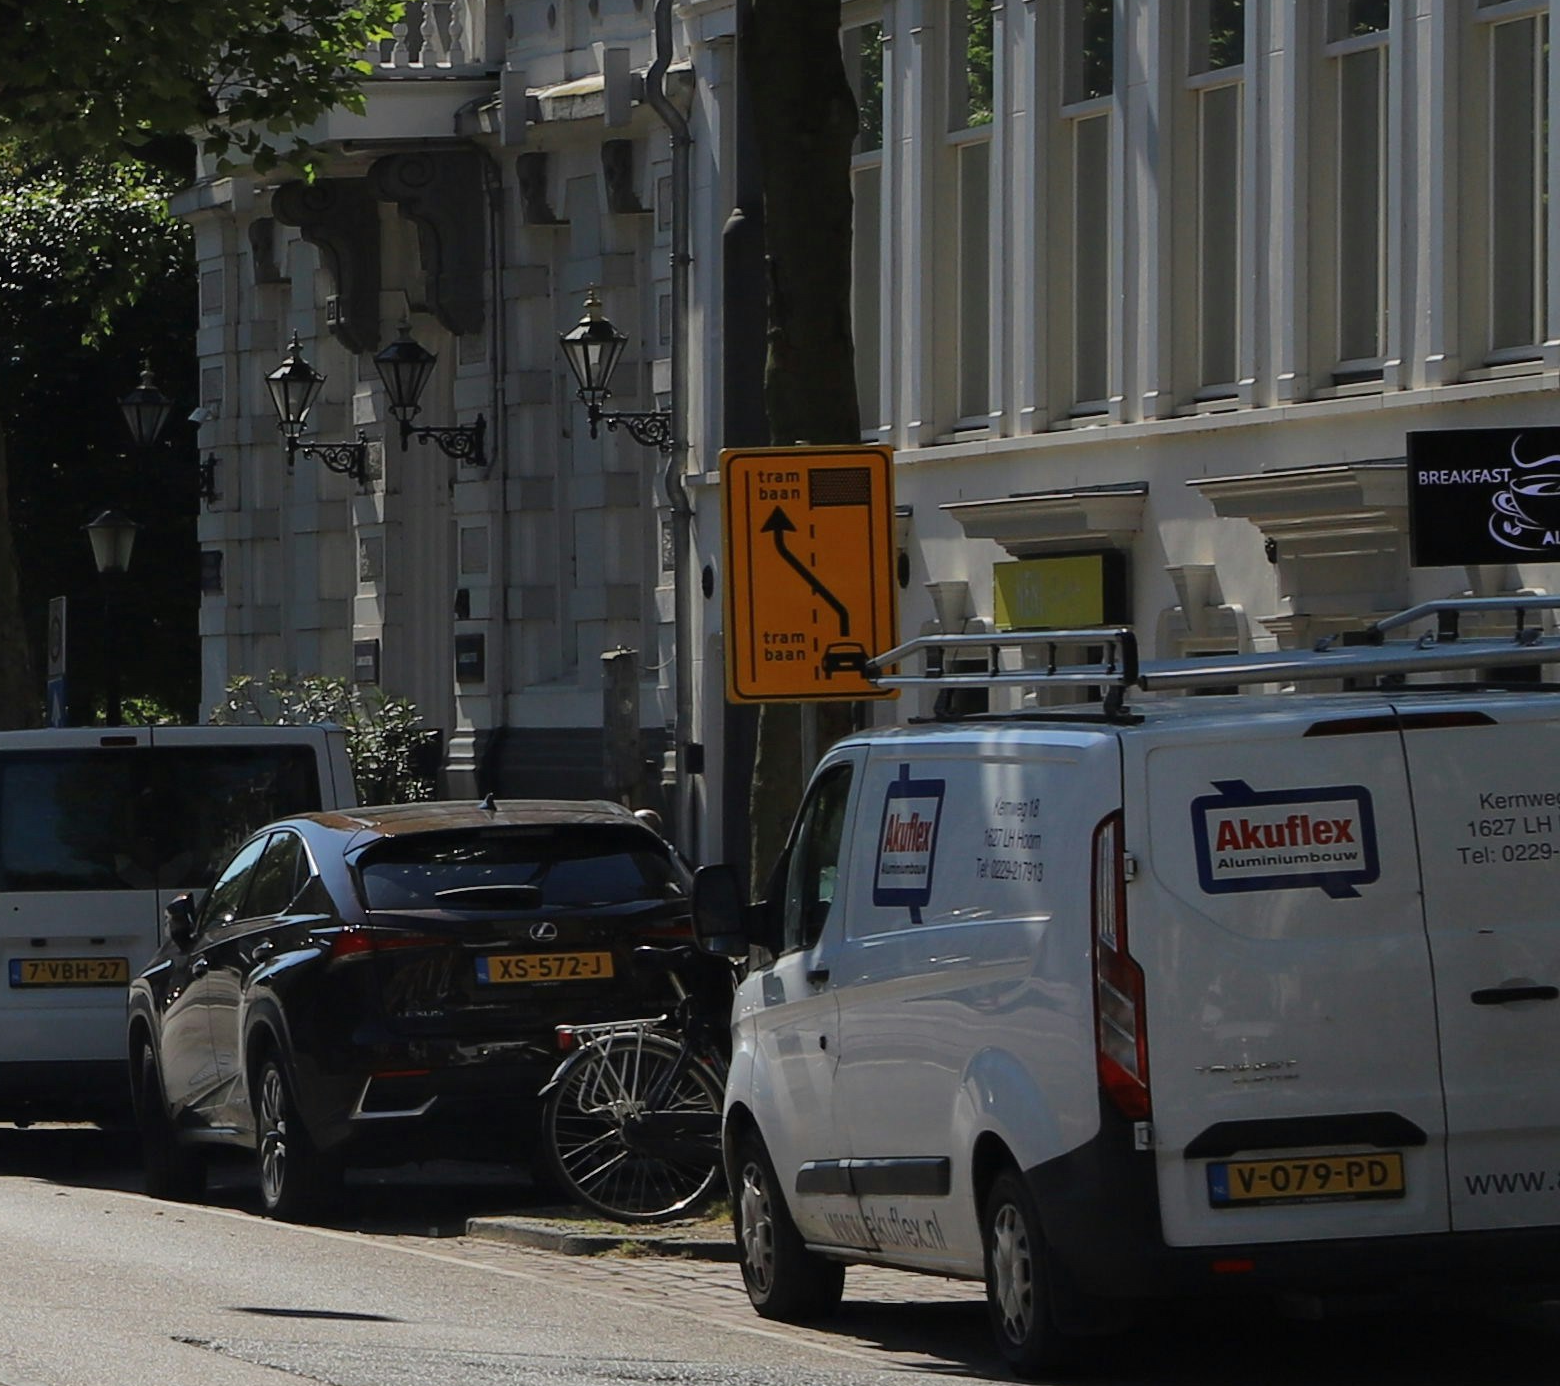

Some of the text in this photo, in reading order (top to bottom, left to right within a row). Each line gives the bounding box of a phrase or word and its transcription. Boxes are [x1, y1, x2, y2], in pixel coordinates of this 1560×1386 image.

[757, 470, 800, 483] tram
[1418, 468, 1512, 485] BREAKFAST
[759, 487, 801, 501] baan
[763, 631, 805, 644] tram
[765, 647, 806, 661] baan
[1480, 792, 1560, 810] Kernwe
[883, 812, 933, 854] Akuflex
[1216, 815, 1355, 852] Akuflex
[1467, 818, 1516, 837] 1627
[1523, 815, 1552, 834] LH
[1217, 851, 1359, 869] Aluminiumbouw
[1456, 843, 1559, 865] Tel: 0229-
[499, 956, 602, 980] XS-572-J
[1237, 1160, 1389, 1193] V-079-PD
[1464, 1170, 1560, 1195] www.
